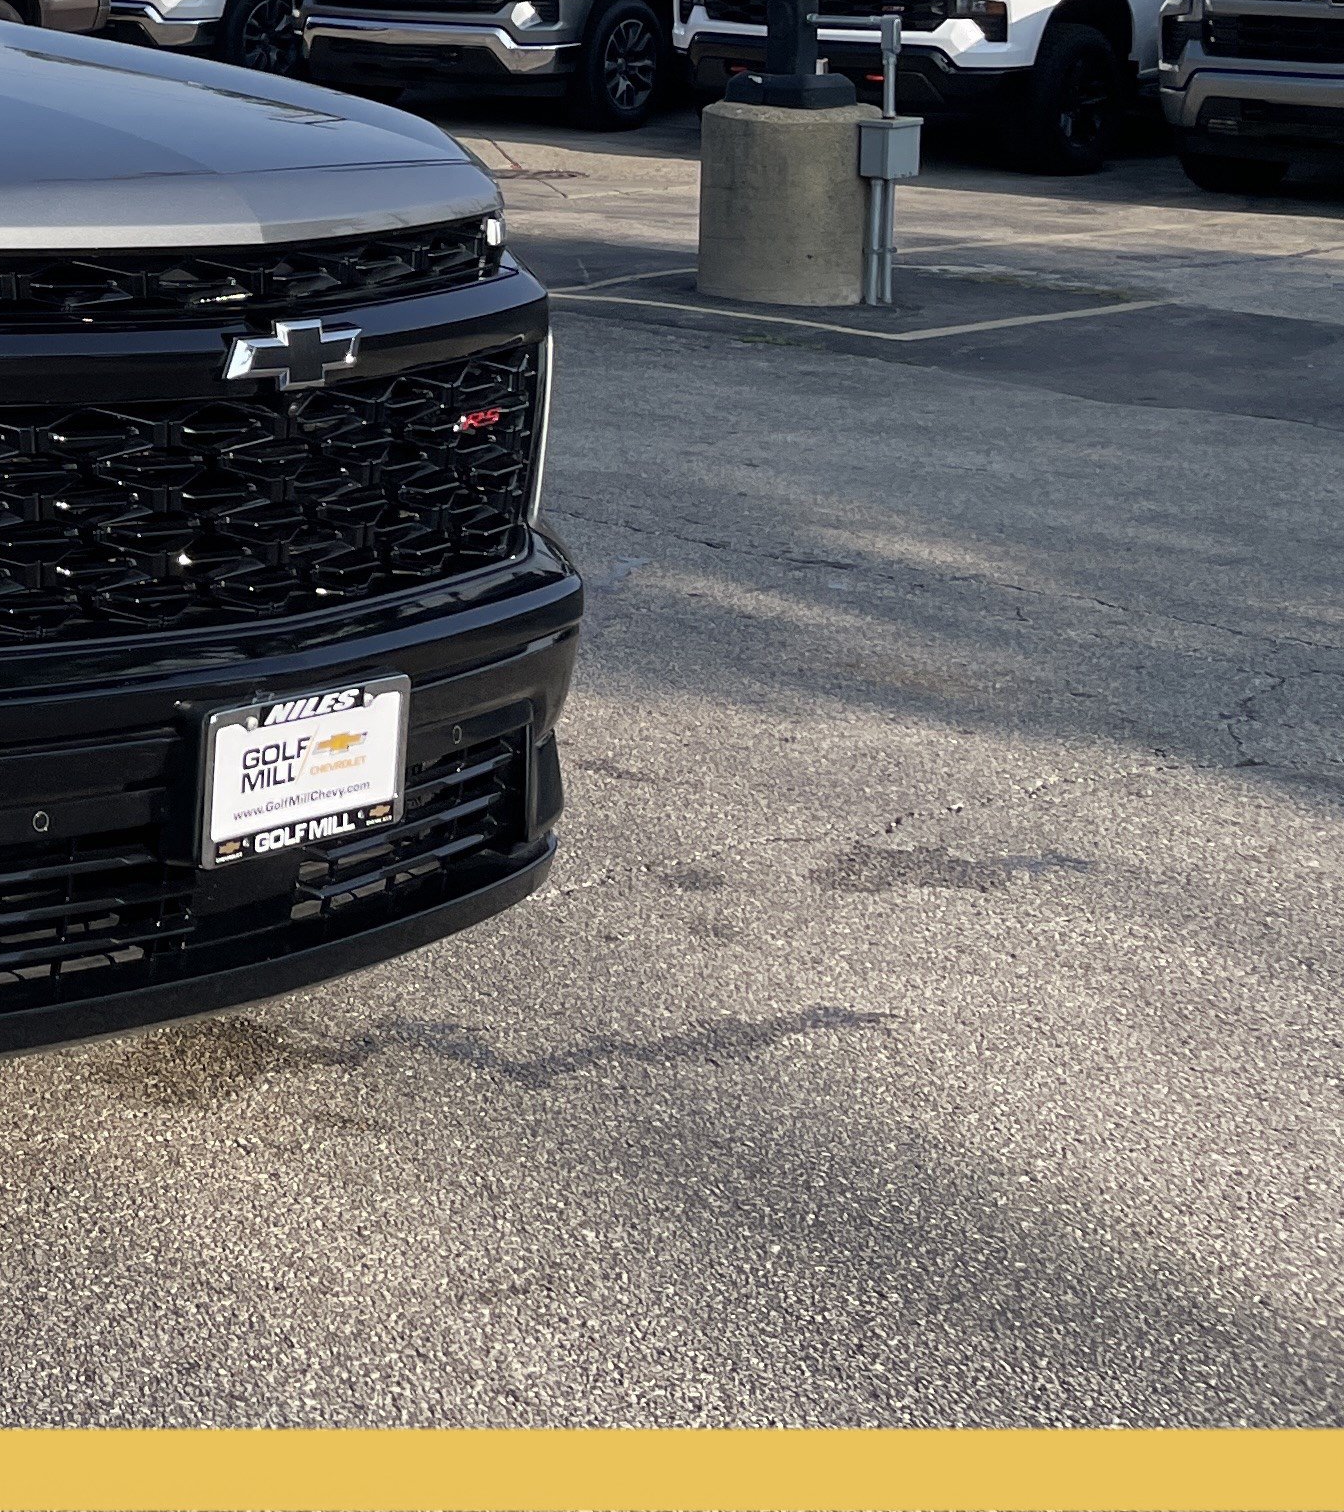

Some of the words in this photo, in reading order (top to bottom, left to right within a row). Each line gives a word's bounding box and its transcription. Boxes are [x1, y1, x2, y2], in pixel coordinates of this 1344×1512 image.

[263, 688, 360, 726] NILES
[242, 736, 311, 770] GOLF
[240, 763, 296, 794] MILL
[232, 780, 371, 822] www.GolfMillChevy.com
[254, 822, 308, 853] GOLF
[308, 813, 356, 841] MILL
